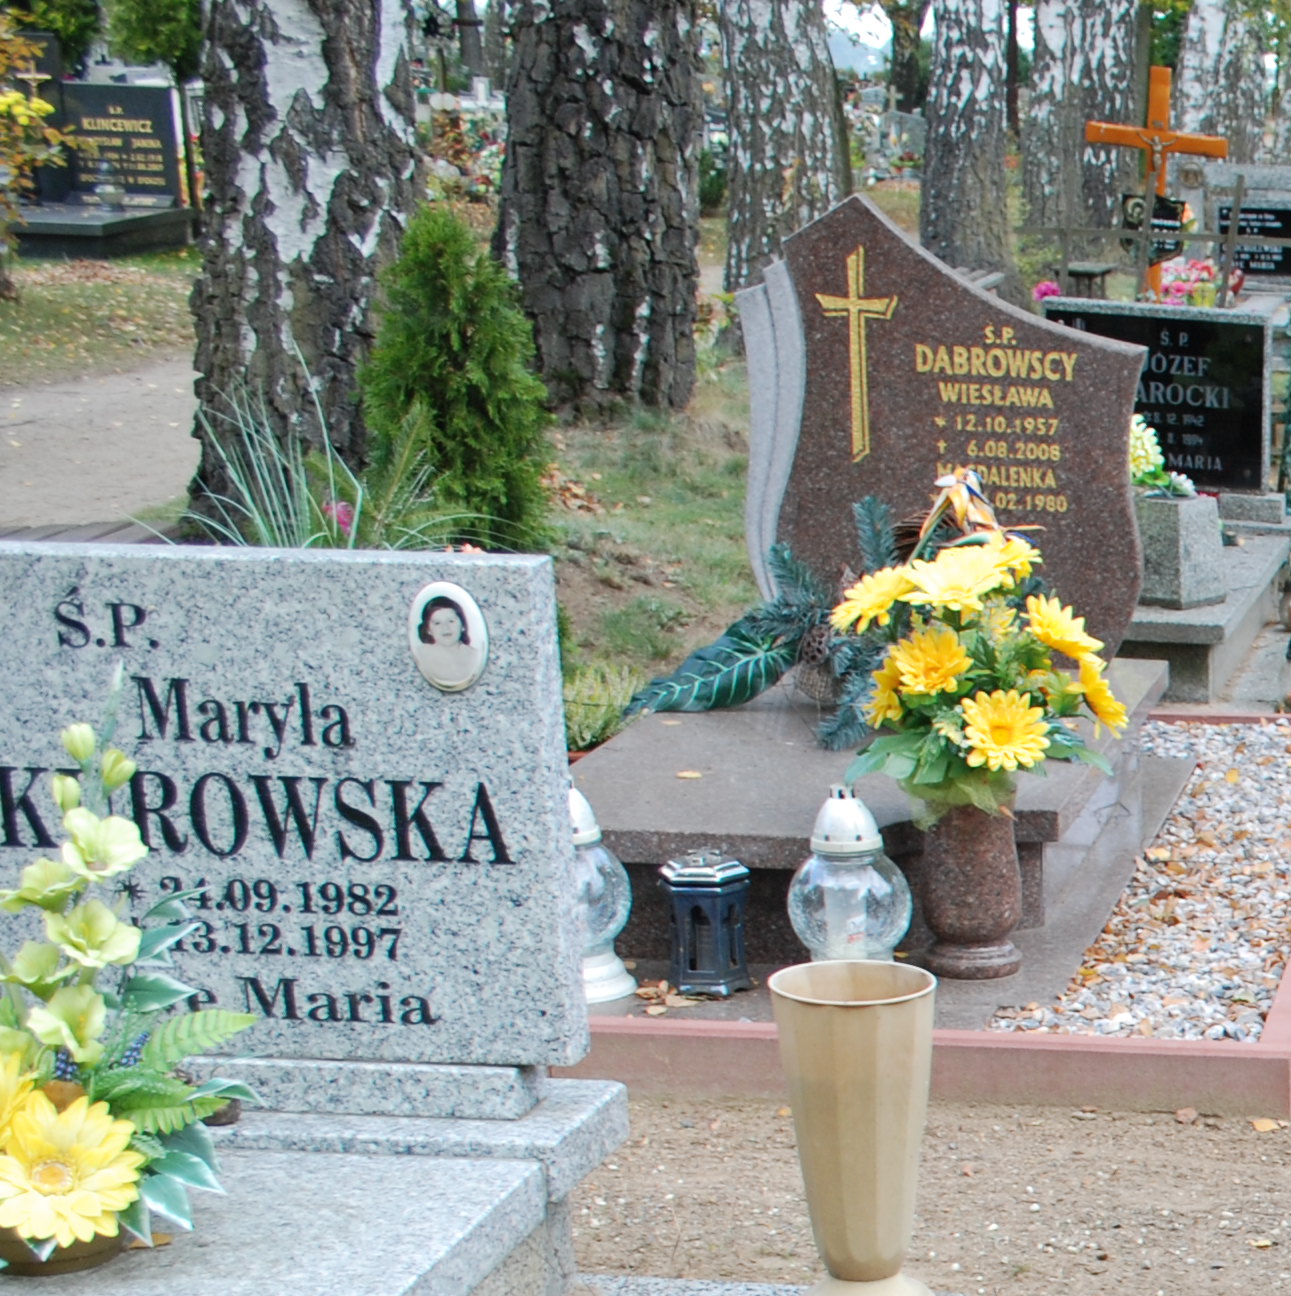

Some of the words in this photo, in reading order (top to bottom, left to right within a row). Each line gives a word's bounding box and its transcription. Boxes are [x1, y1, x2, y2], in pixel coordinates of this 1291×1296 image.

[939, 382, 1054, 409] WIESŁAWA
[1133, 382, 1230, 409] AROCKI
[956, 414, 1059, 435] 12.10.1957
[967, 440, 1061, 461] 6.08.2008
[1168, 453, 1223, 471] MARIA
[937, 462, 1057, 488] MDALENKA
[976, 491, 1068, 512] .02.1980
[53, 586, 160, 649] Ś.P.
[131, 676, 356, 759] Maryla
[236, 976, 441, 1026] Maria
